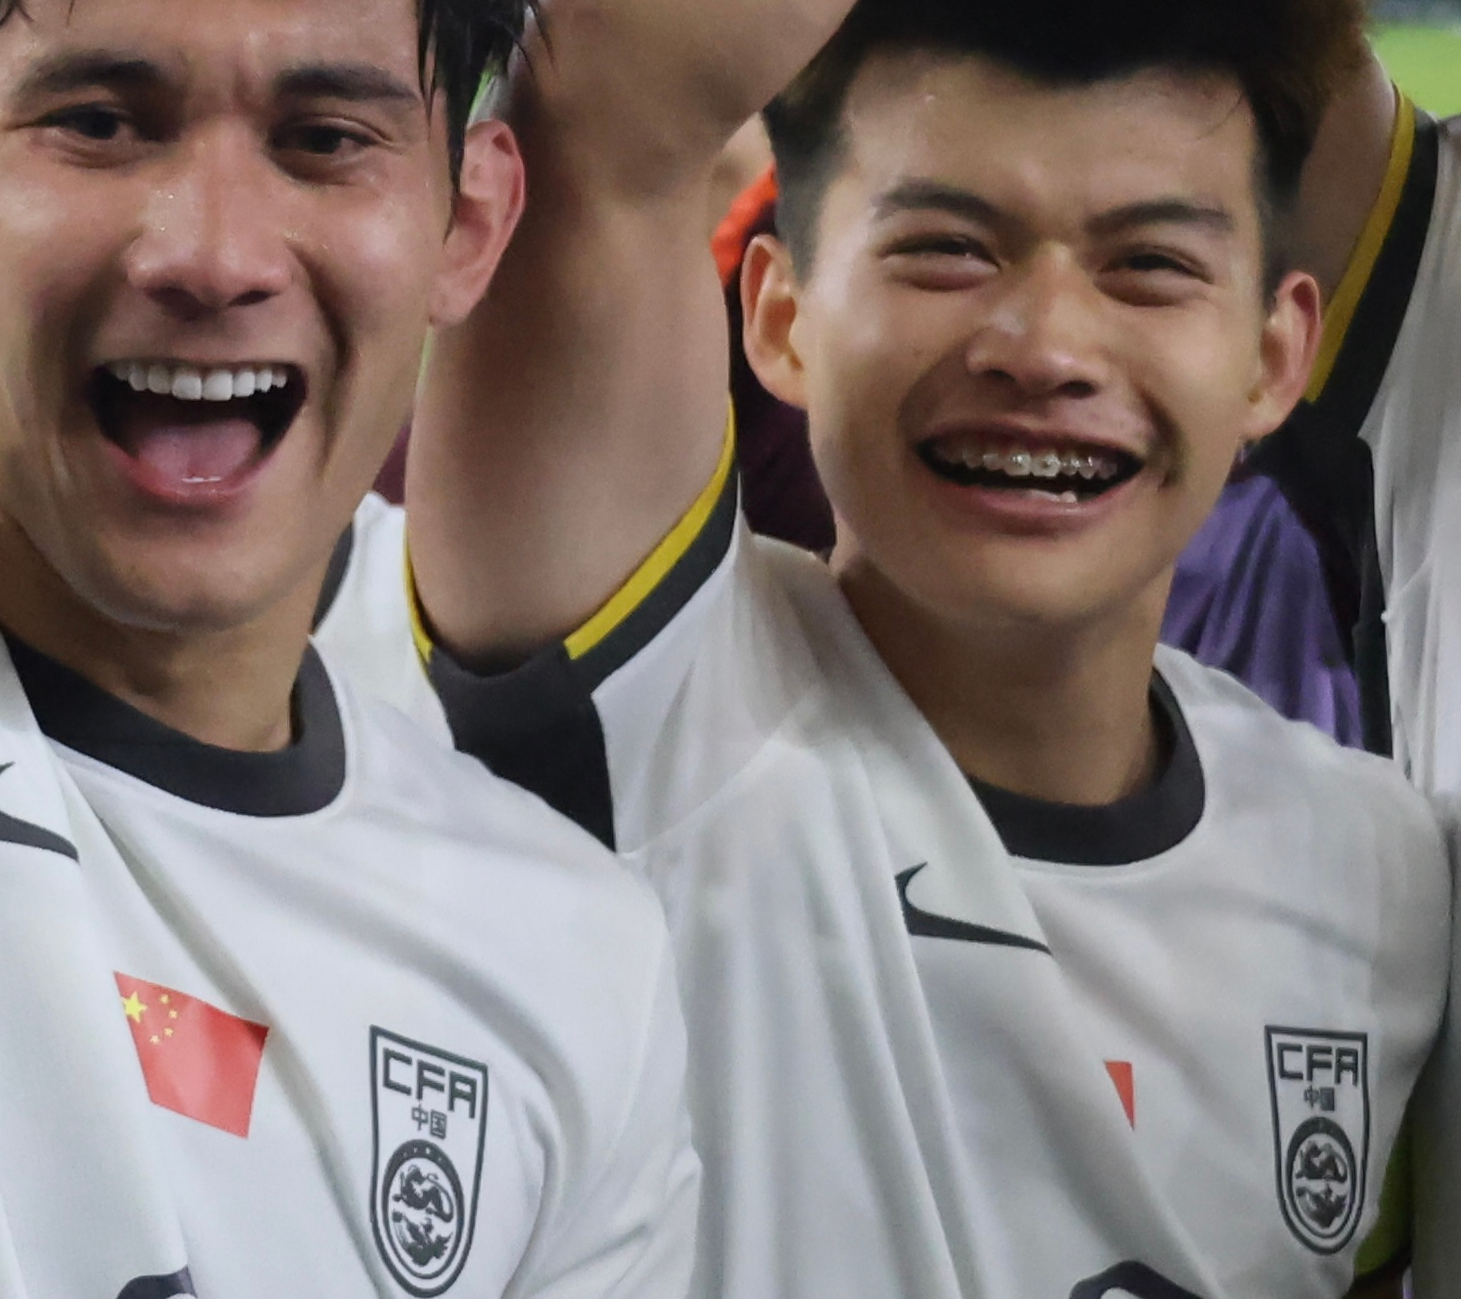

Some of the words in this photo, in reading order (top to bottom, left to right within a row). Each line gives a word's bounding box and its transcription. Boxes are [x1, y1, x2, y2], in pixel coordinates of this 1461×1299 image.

[382, 1046, 478, 1120] CFA
[1276, 1041, 1359, 1086] CFA
[411, 1103, 448, 1140] 中国
